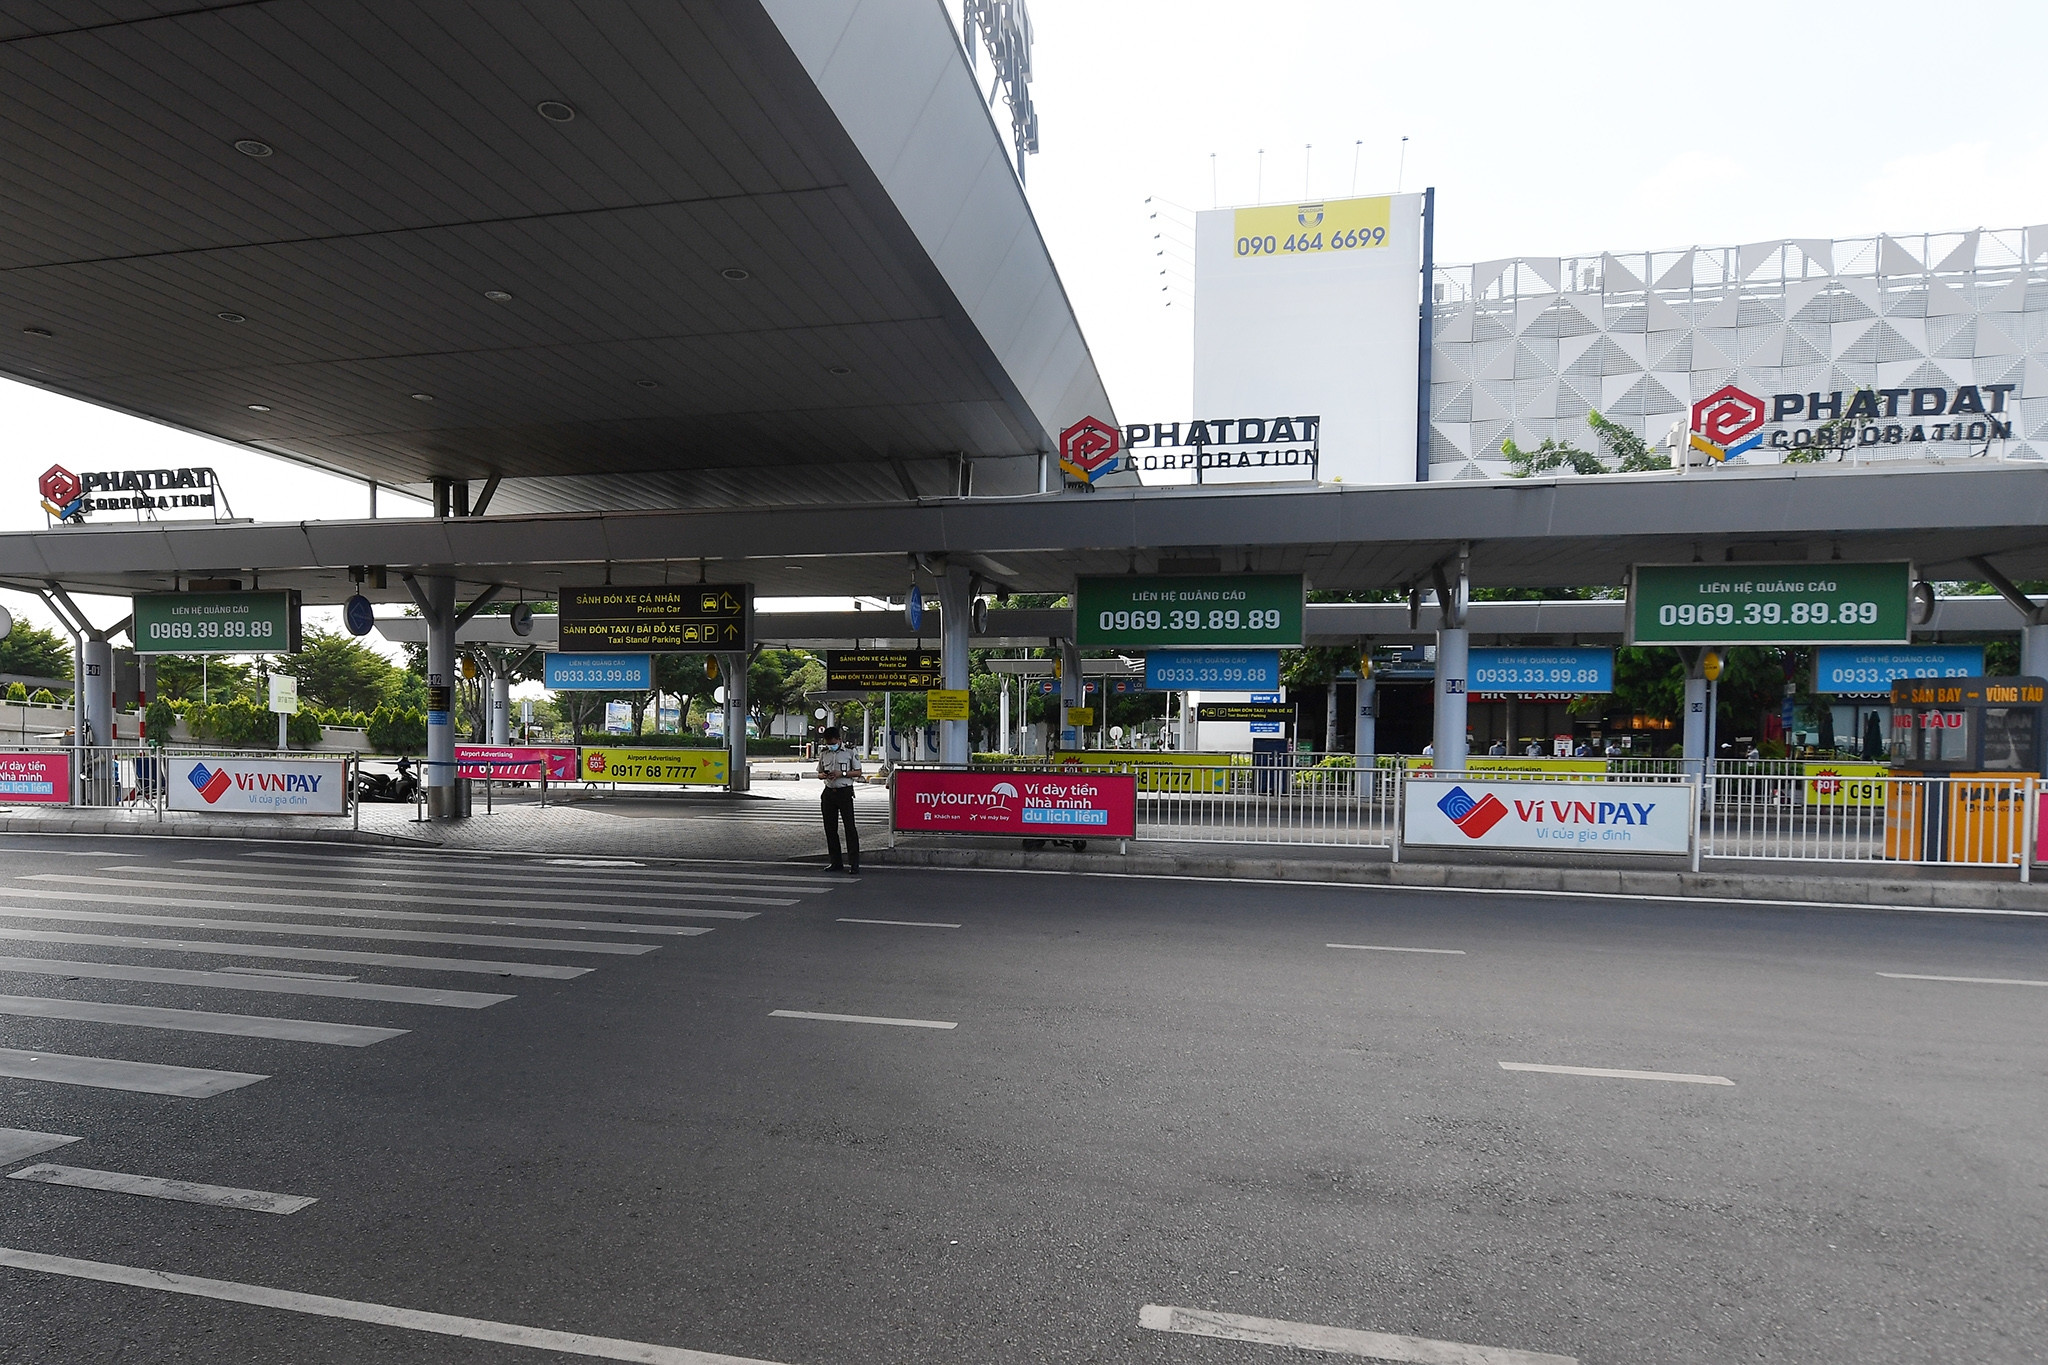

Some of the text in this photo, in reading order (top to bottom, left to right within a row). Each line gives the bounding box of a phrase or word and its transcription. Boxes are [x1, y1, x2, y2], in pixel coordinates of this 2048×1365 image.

[1237, 226, 1386, 256] 090 464 6699
[1773, 384, 2016, 421] PHATDAT
[1126, 415, 1320, 448] PHATDAT
[1770, 421, 2012, 447] CORPORATION
[1125, 449, 1317, 471] CORPORATION
[82, 468, 212, 492] PHATDAT
[84, 494, 214, 510] CORPORATION
[1699, 580, 1836, 594] LIÊN HỆ QUẢNG CÁO
[576, 593, 680, 604] SẢNH ĐÓN XE CÁ NHÂN
[1132, 590, 1246, 602] LIÊN HỆ QUẢNG CÁO
[172, 604, 249, 616] LIÊN HỆ QUẢNG CÁO
[1659, 602, 1878, 626] 0969.39.89.89
[1100, 609, 1280, 630] 0969.39.89.89
[150, 621, 272, 638] 0969.39.89.89
[563, 624, 586, 634] SẢNH
[589, 624, 608, 634] ĐÓN
[610, 626, 630, 634] TAXI
[636, 624, 650, 633] BÃI
[654, 621, 666, 633] ĐỖ
[608, 636, 624, 644] Taxi
[652, 636, 680, 645] Parking
[554, 670, 641, 682] 0933.33.99.88
[1158, 668, 1266, 682] 0933.33.99.88
[1476, 669, 1598, 683] 0933.33.99.88
[1938, 688, 1962, 702] BAY
[1986, 684, 2044, 702] VŨNG TÀU
[1918, 709, 1963, 729] TÀU
[460, 750, 514, 759] Airport Advertising
[10, 761, 26, 772] dày
[28, 760, 46, 771] tiền
[611, 764, 697, 778] 0917 68 7777
[19, 772, 42, 782] mình
[235, 773, 322, 792] Ví VNPAY
[1154, 772, 1192, 786] 7777
[13, 782, 28, 794] lịch
[1025, 783, 1098, 798] Ví dày tiền
[259, 794, 272, 803] của
[275, 796, 286, 806] gia
[289, 796, 308, 804] đình
[916, 790, 997, 808] mytour.vn
[1025, 797, 1092, 809] Nhà mình
[1024, 810, 1104, 824] du lịch liền!
[1514, 800, 1656, 826] Ví VNPAY
[1552, 827, 1574, 839] của
[1578, 829, 1598, 842] gia
[1602, 829, 1631, 840] đình
